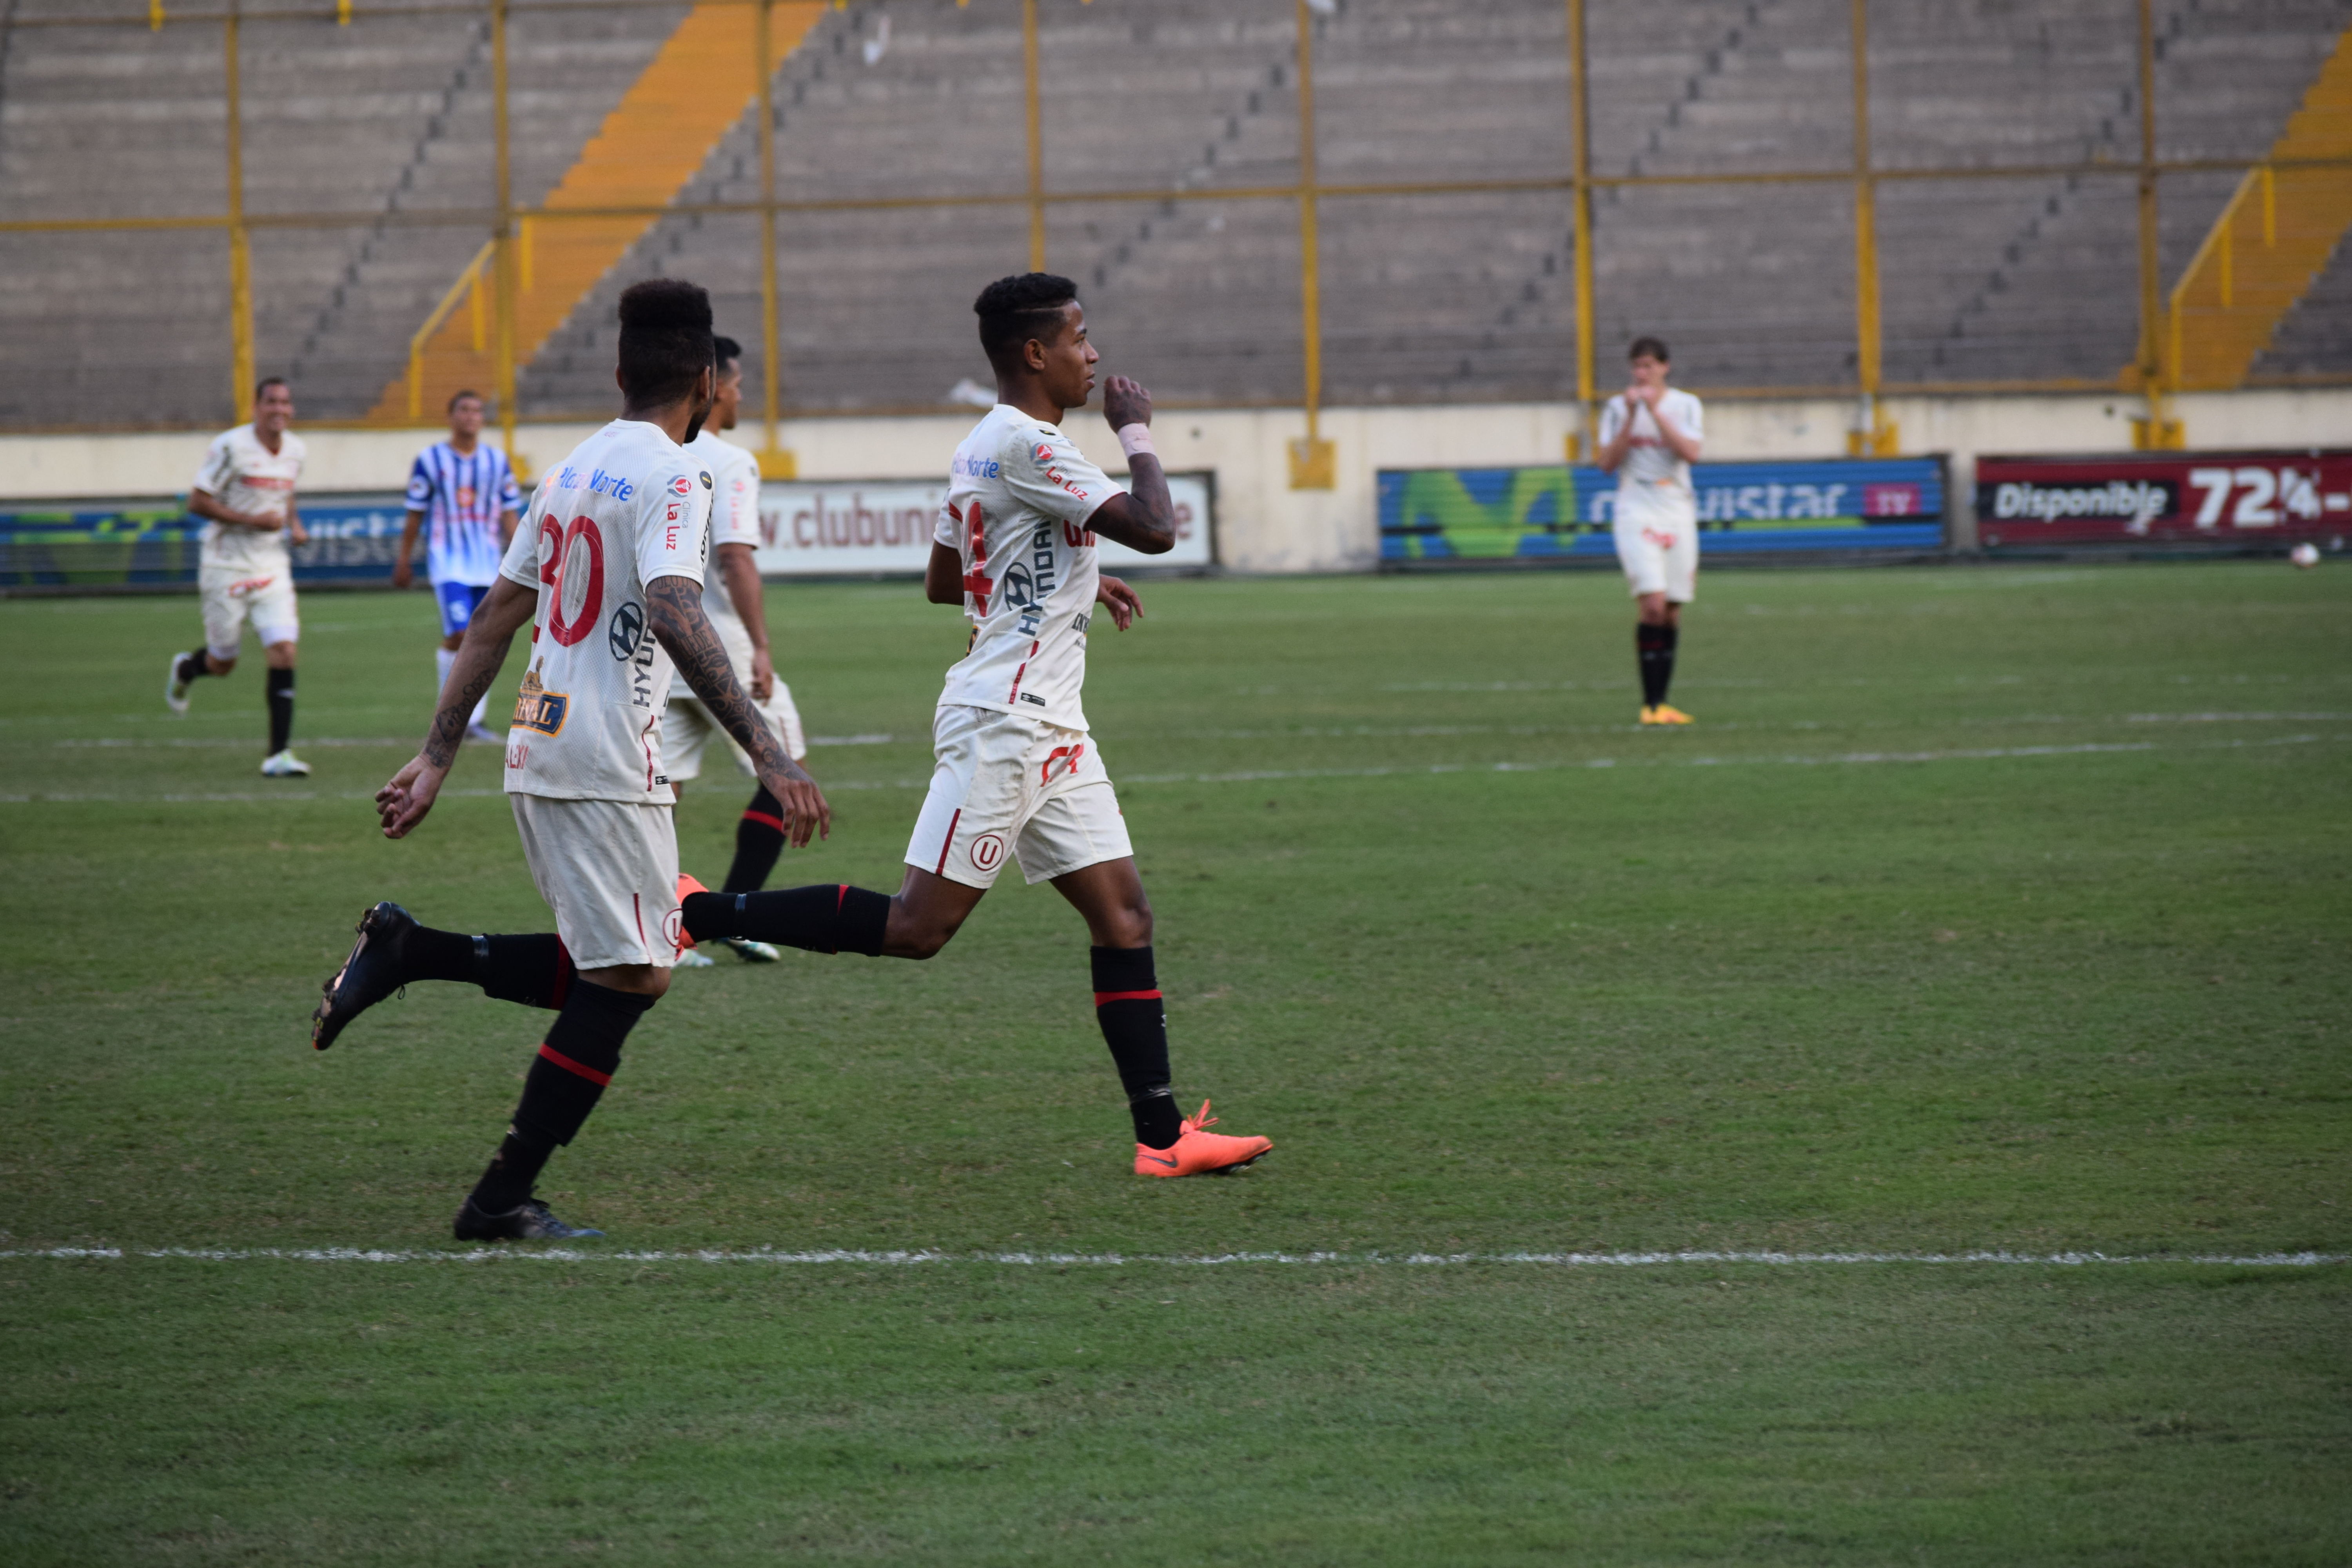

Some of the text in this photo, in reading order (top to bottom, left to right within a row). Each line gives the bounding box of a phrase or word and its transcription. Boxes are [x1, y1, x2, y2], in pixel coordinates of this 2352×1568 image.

[1045, 466, 1089, 501] La Luz
[666, 503, 681, 550] La Luz
[682, 501, 691, 529] Clínica
[980, 842, 998, 865] U
